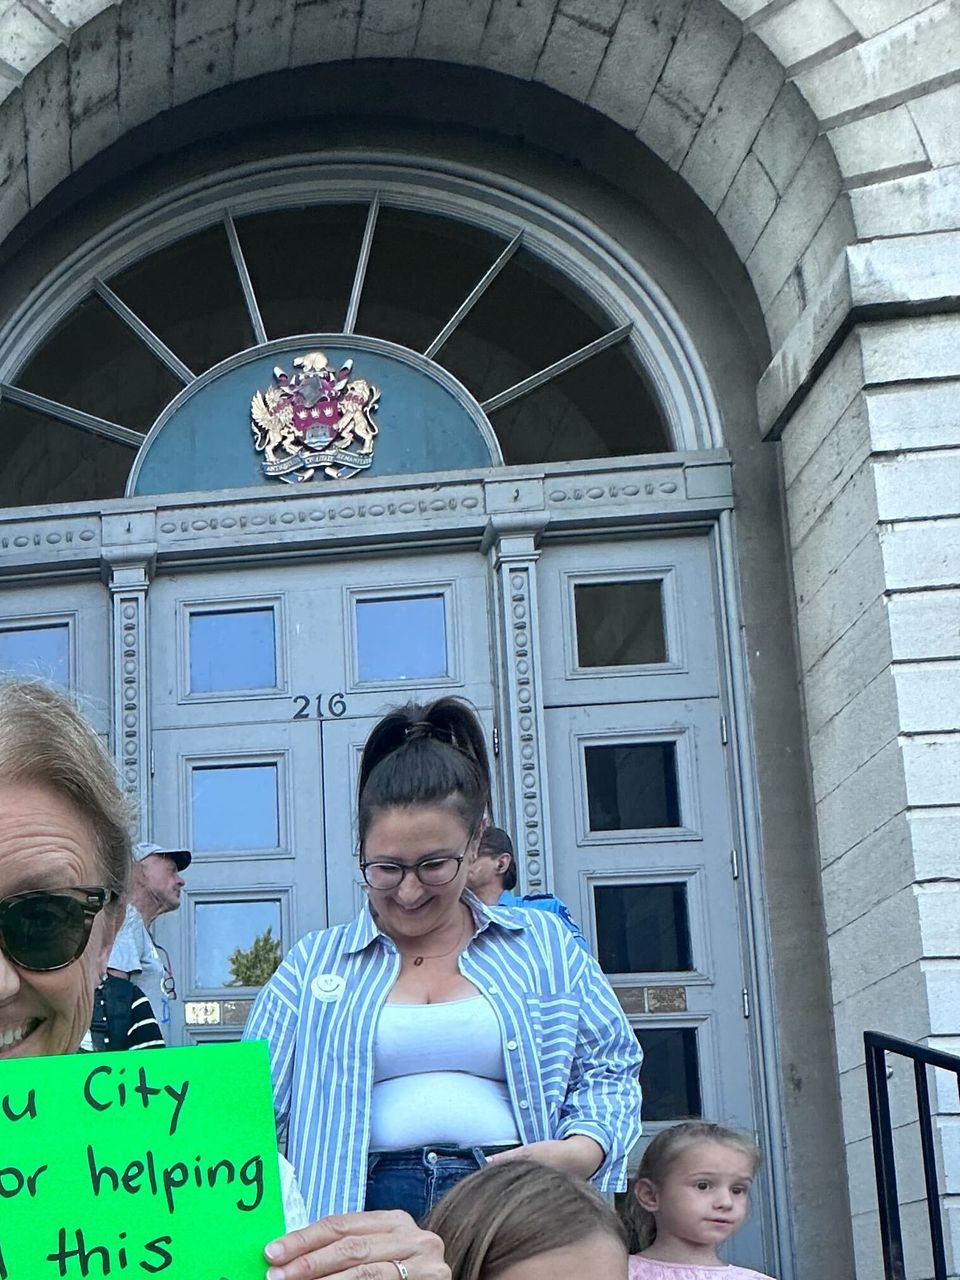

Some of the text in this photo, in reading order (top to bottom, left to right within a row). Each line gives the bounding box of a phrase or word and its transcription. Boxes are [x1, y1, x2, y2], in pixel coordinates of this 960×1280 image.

[292, 692, 347, 719] 216
[84, 1065, 190, 1135] City
[87, 1144, 265, 1212] helping
[47, 1228, 174, 1277] this
